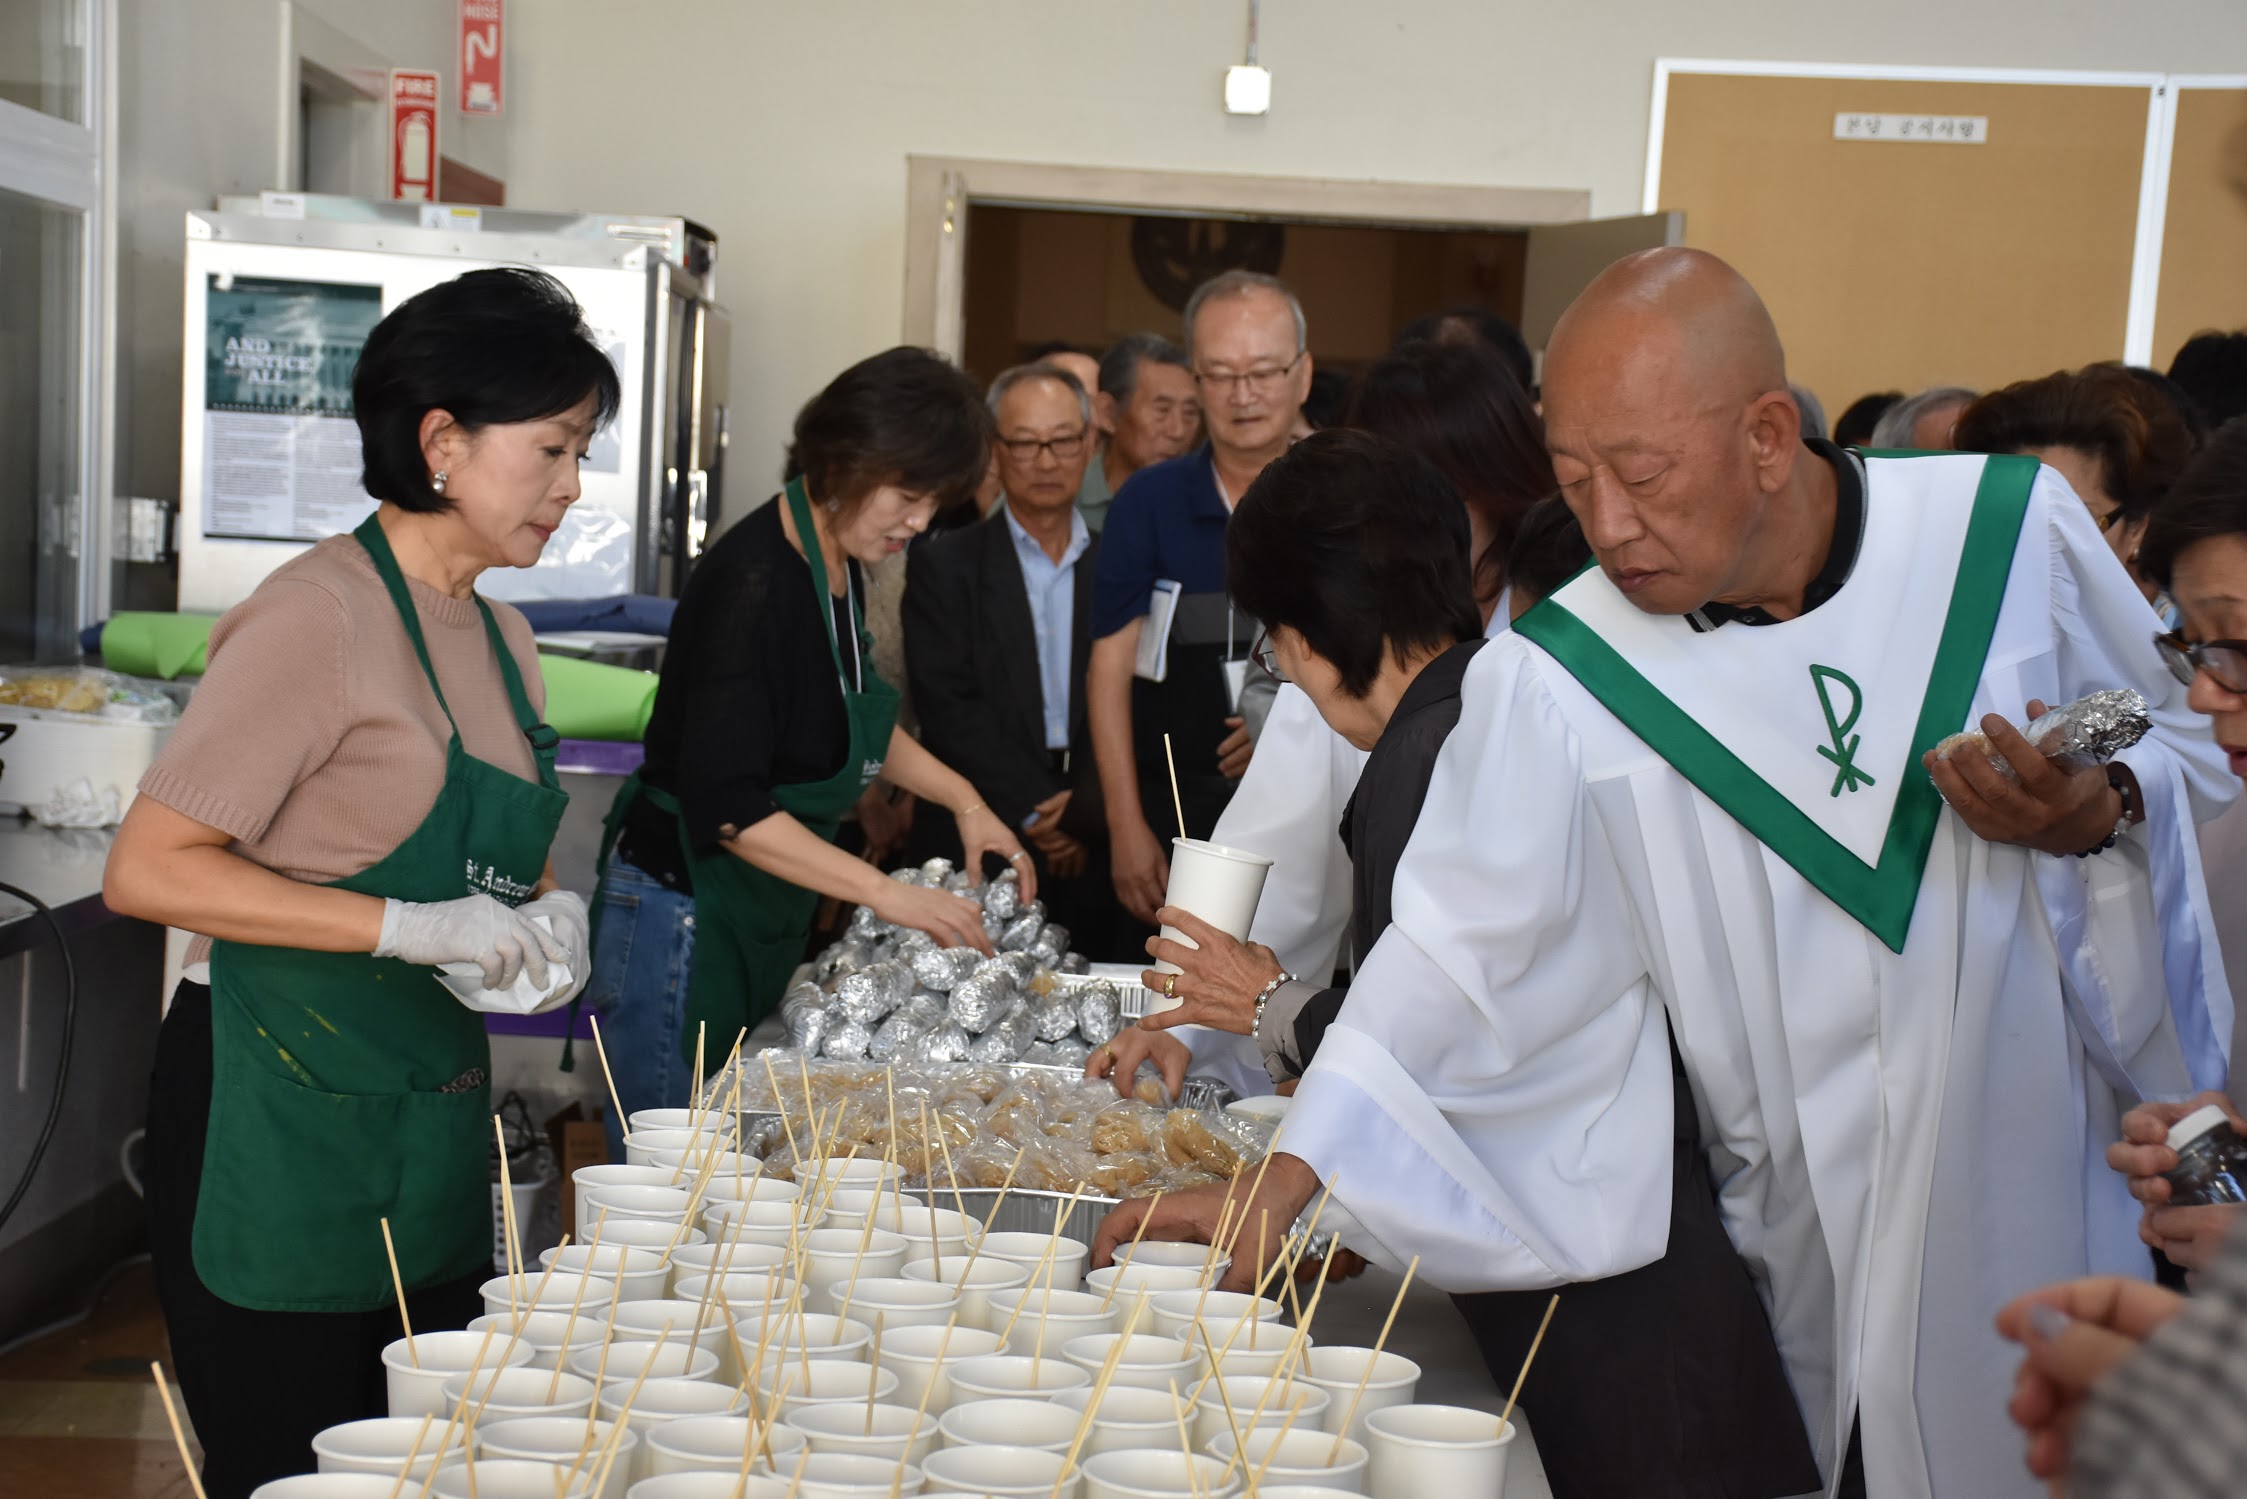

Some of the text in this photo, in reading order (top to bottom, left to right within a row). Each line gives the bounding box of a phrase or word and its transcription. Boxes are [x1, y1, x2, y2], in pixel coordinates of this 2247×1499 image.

[396, 78, 434, 97] FIRE
[226, 337, 271, 352] AND
[225, 353, 312, 371] JUSTICE
[248, 369, 286, 385] ALL
